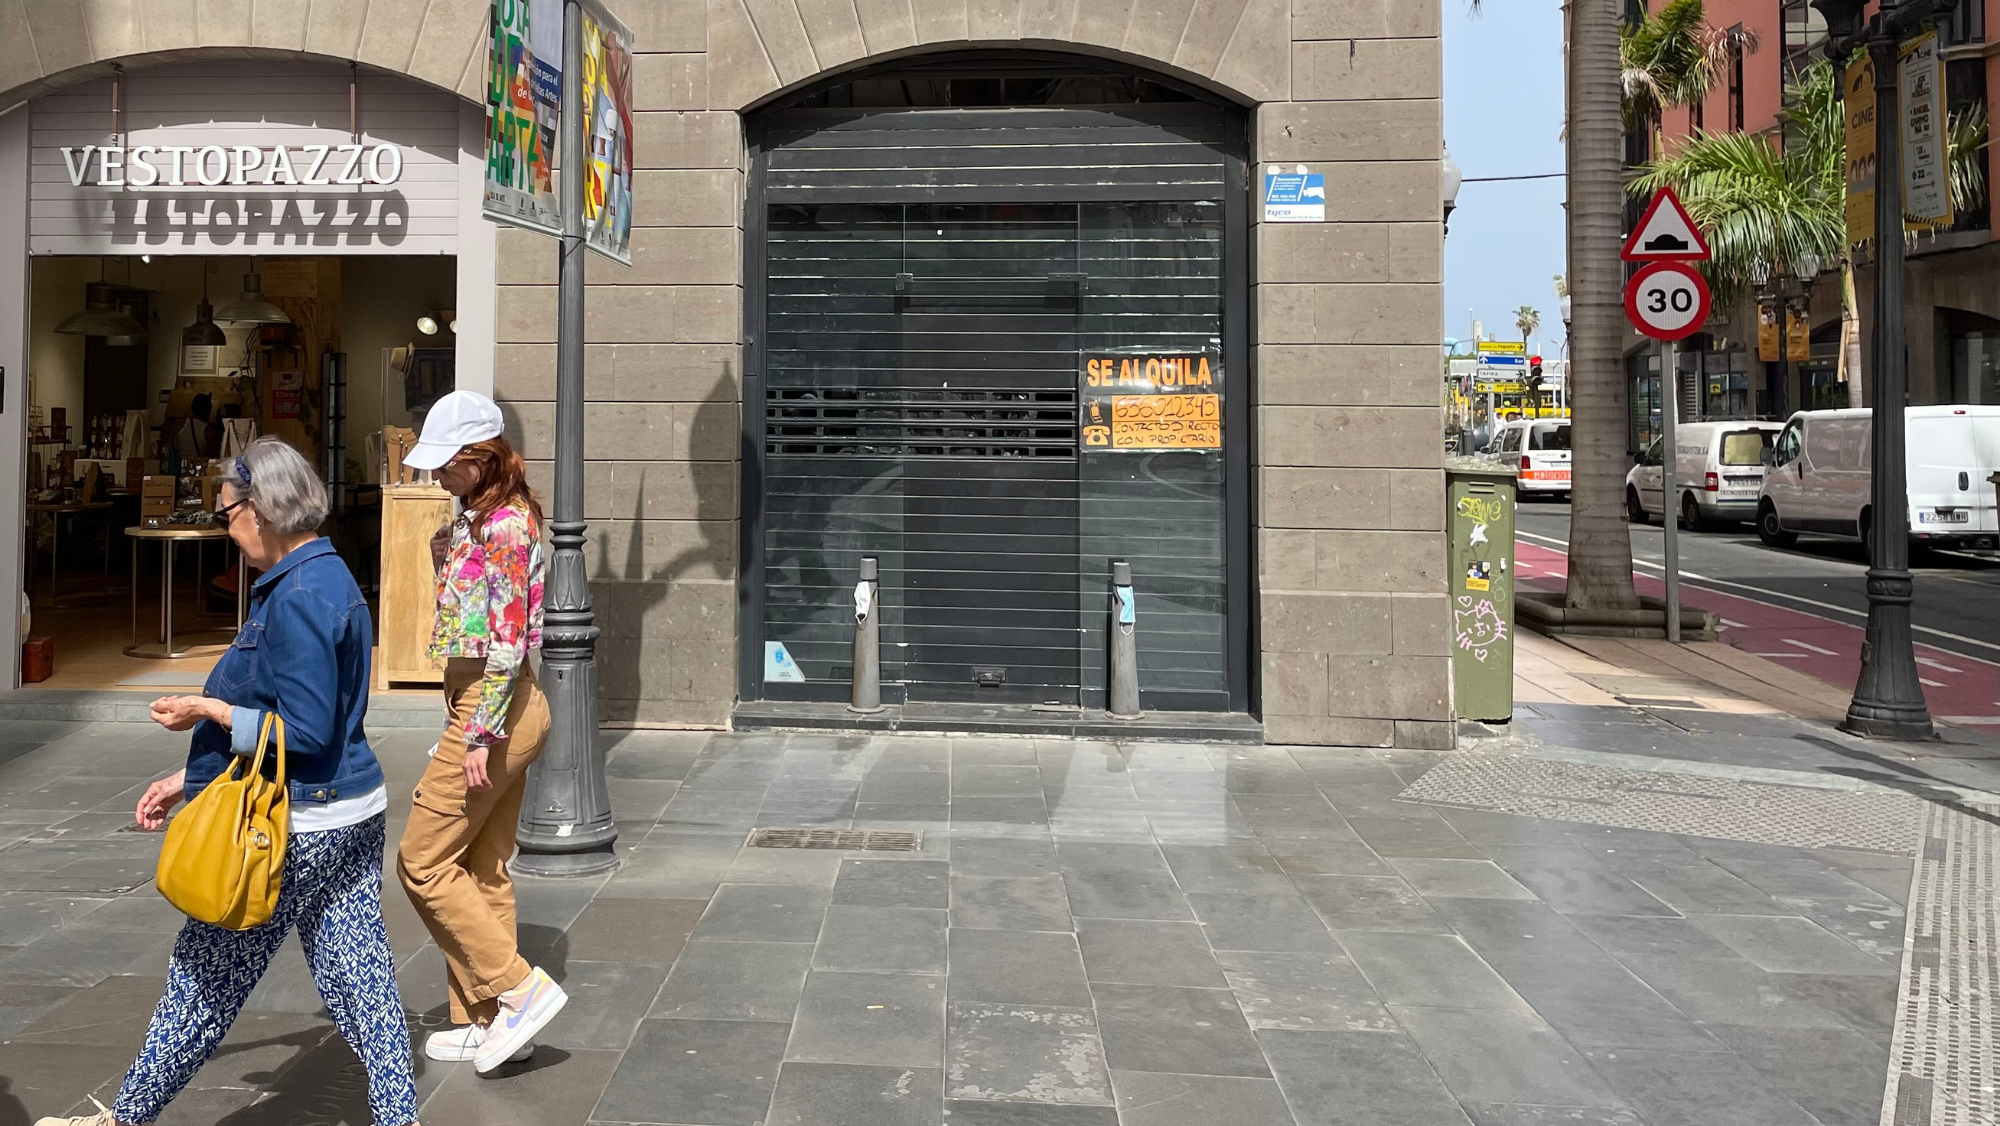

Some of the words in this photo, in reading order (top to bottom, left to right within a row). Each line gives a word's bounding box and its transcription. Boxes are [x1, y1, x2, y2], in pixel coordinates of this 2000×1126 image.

[517, 86, 528, 99] de
[1851, 105, 1874, 129] CINE
[487, 106, 540, 195] ARTE
[60, 144, 404, 187] VESTOPAZZO
[1267, 209, 1291, 217] tyco
[1647, 288, 1693, 313] 30
[1086, 358, 1114, 388] SE
[1118, 357, 1213, 388] ALQUILA
[1115, 396, 1216, 418] 636012345
[1116, 435, 1144, 446] CON
